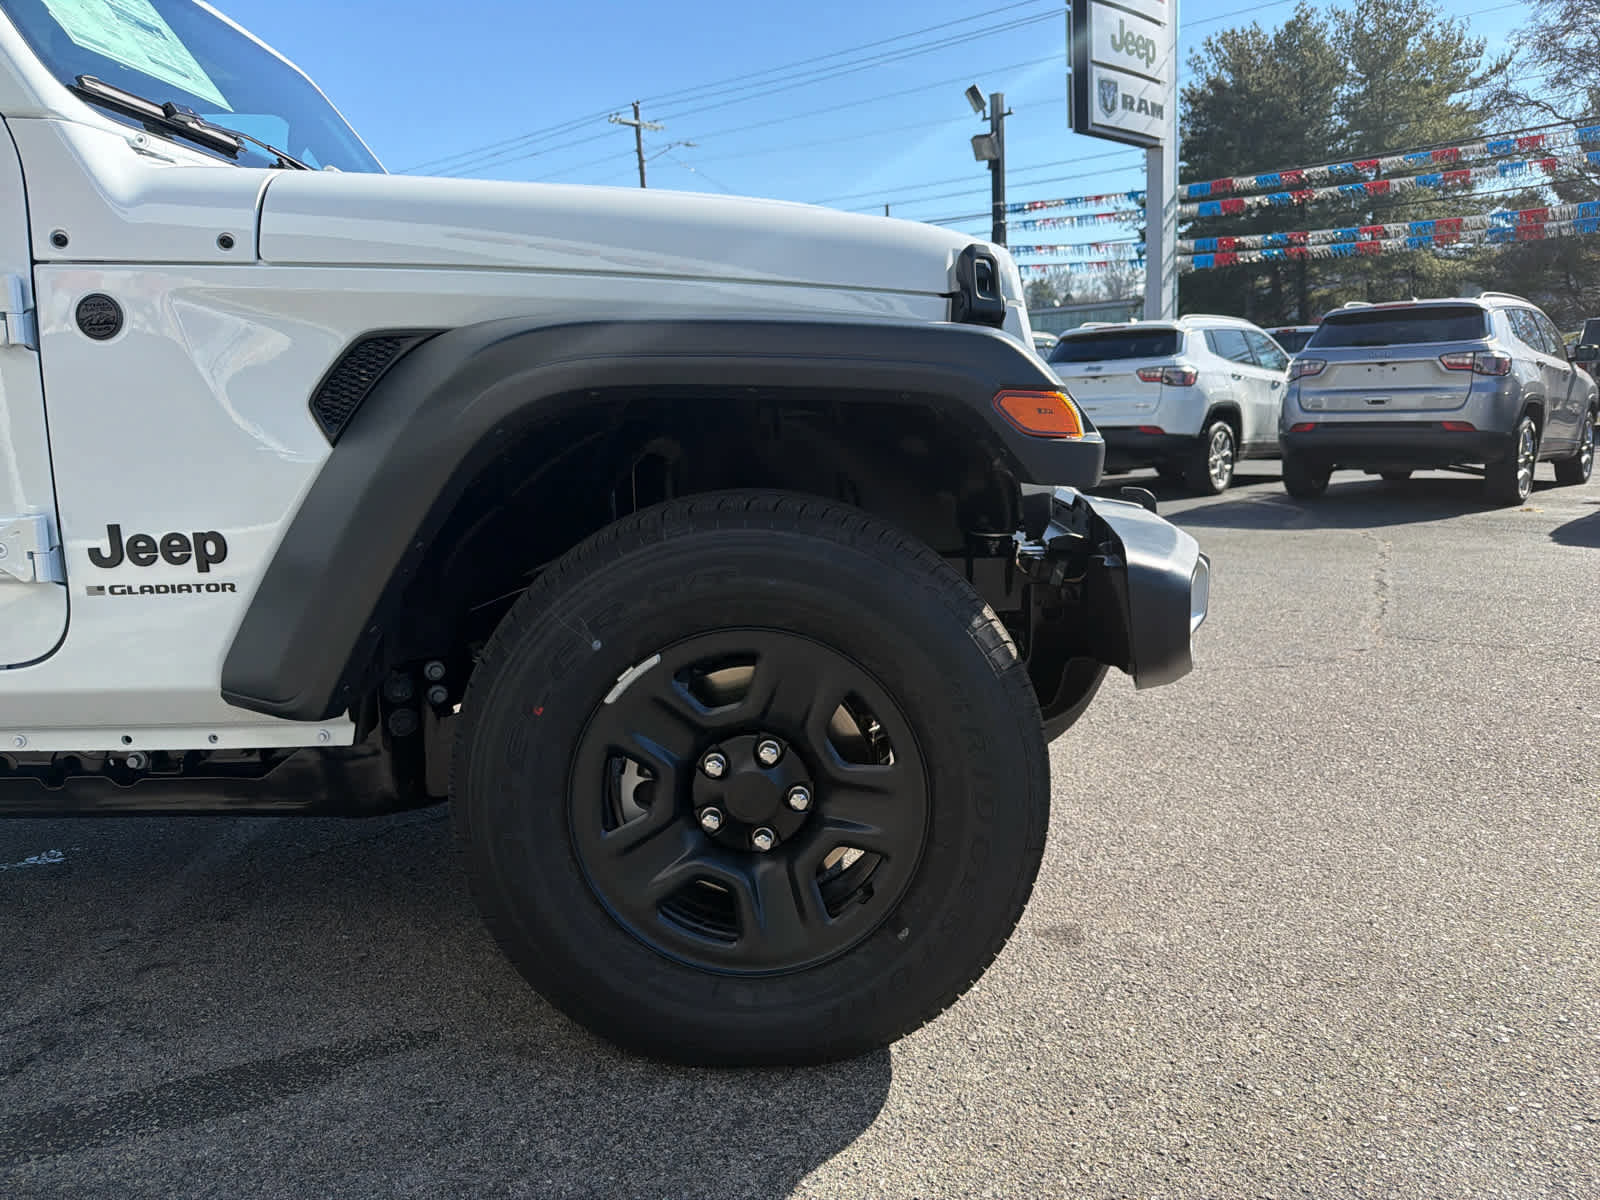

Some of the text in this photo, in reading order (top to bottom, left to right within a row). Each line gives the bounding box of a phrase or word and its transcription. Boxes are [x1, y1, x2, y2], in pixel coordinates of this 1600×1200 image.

[1111, 18, 1156, 69] Jeep
[1121, 93, 1164, 120] RAM
[87, 523, 228, 573] Jeep
[108, 582, 237, 596] GLADIATOR
